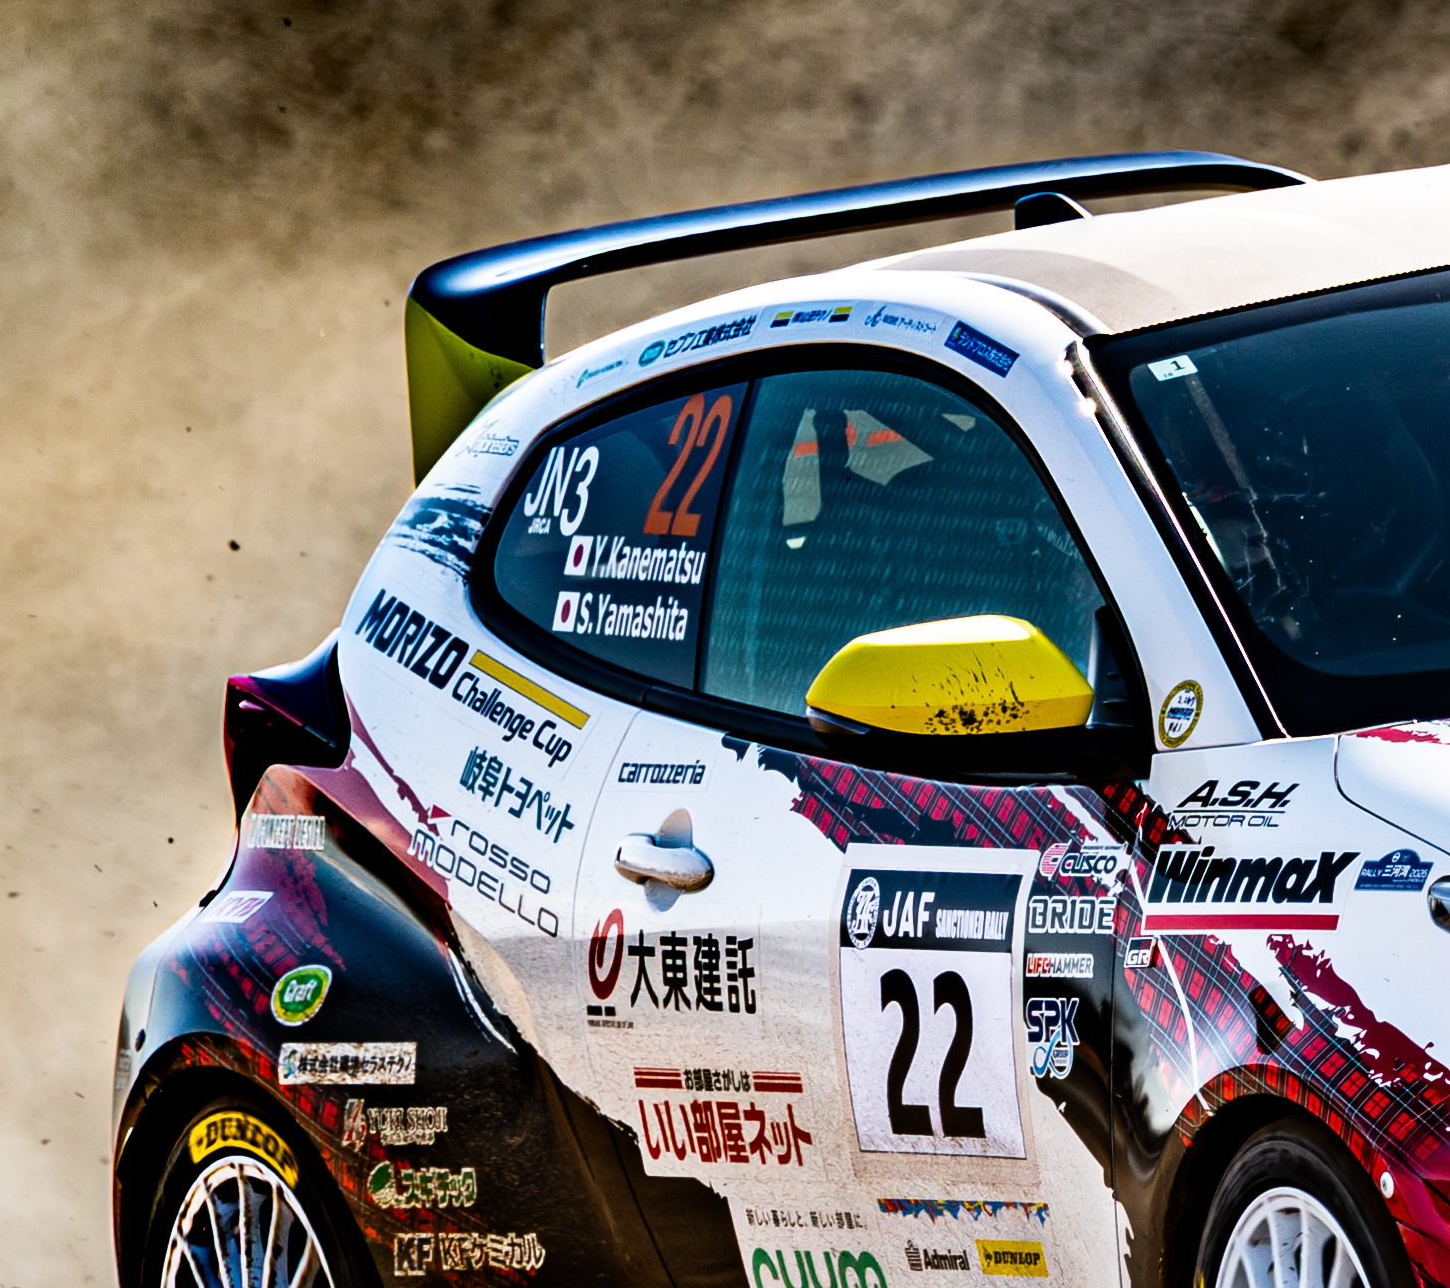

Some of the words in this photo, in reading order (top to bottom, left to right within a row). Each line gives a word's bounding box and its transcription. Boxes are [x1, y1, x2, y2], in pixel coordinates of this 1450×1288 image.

[643, 393, 732, 536] 22
[524, 446, 599, 536] JN3
[592, 535, 706, 584] Y.Kanematsu
[355, 589, 469, 690] MORIZO
[576, 591, 688, 641] S.Yamashita
[451, 671, 534, 742] Challenge
[532, 719, 572, 767] Cup
[460, 746, 574, 843] 岐阜トヨペット
[618, 759, 706, 785] carrozzeria
[1168, 814, 1245, 830] MOTOR
[1247, 815, 1279, 828] OIL
[1061, 852, 1117, 875] CUSCO
[1360, 868, 1382, 877] RALLY
[883, 891, 935, 938] JAF
[935, 909, 985, 940] SANCTIONED
[984, 911, 1009, 940] RALLY
[1029, 896, 1116, 933] BRIDE
[627, 928, 757, 1015] 大東建託
[1126, 950, 1149, 966] GR
[1027, 996, 1080, 1046] SPK
[879, 968, 987, 1139] 22
[683, 1068, 751, 1092] お部屋さがしは
[638, 1098, 813, 1167] いい部屋ネット
[394, 1233, 434, 1276] KF
[438, 1232, 546, 1271] KFケミカル
[923, 1248, 970, 1271] Admiral
[992, 1251, 1040, 1266] DUNLOP
